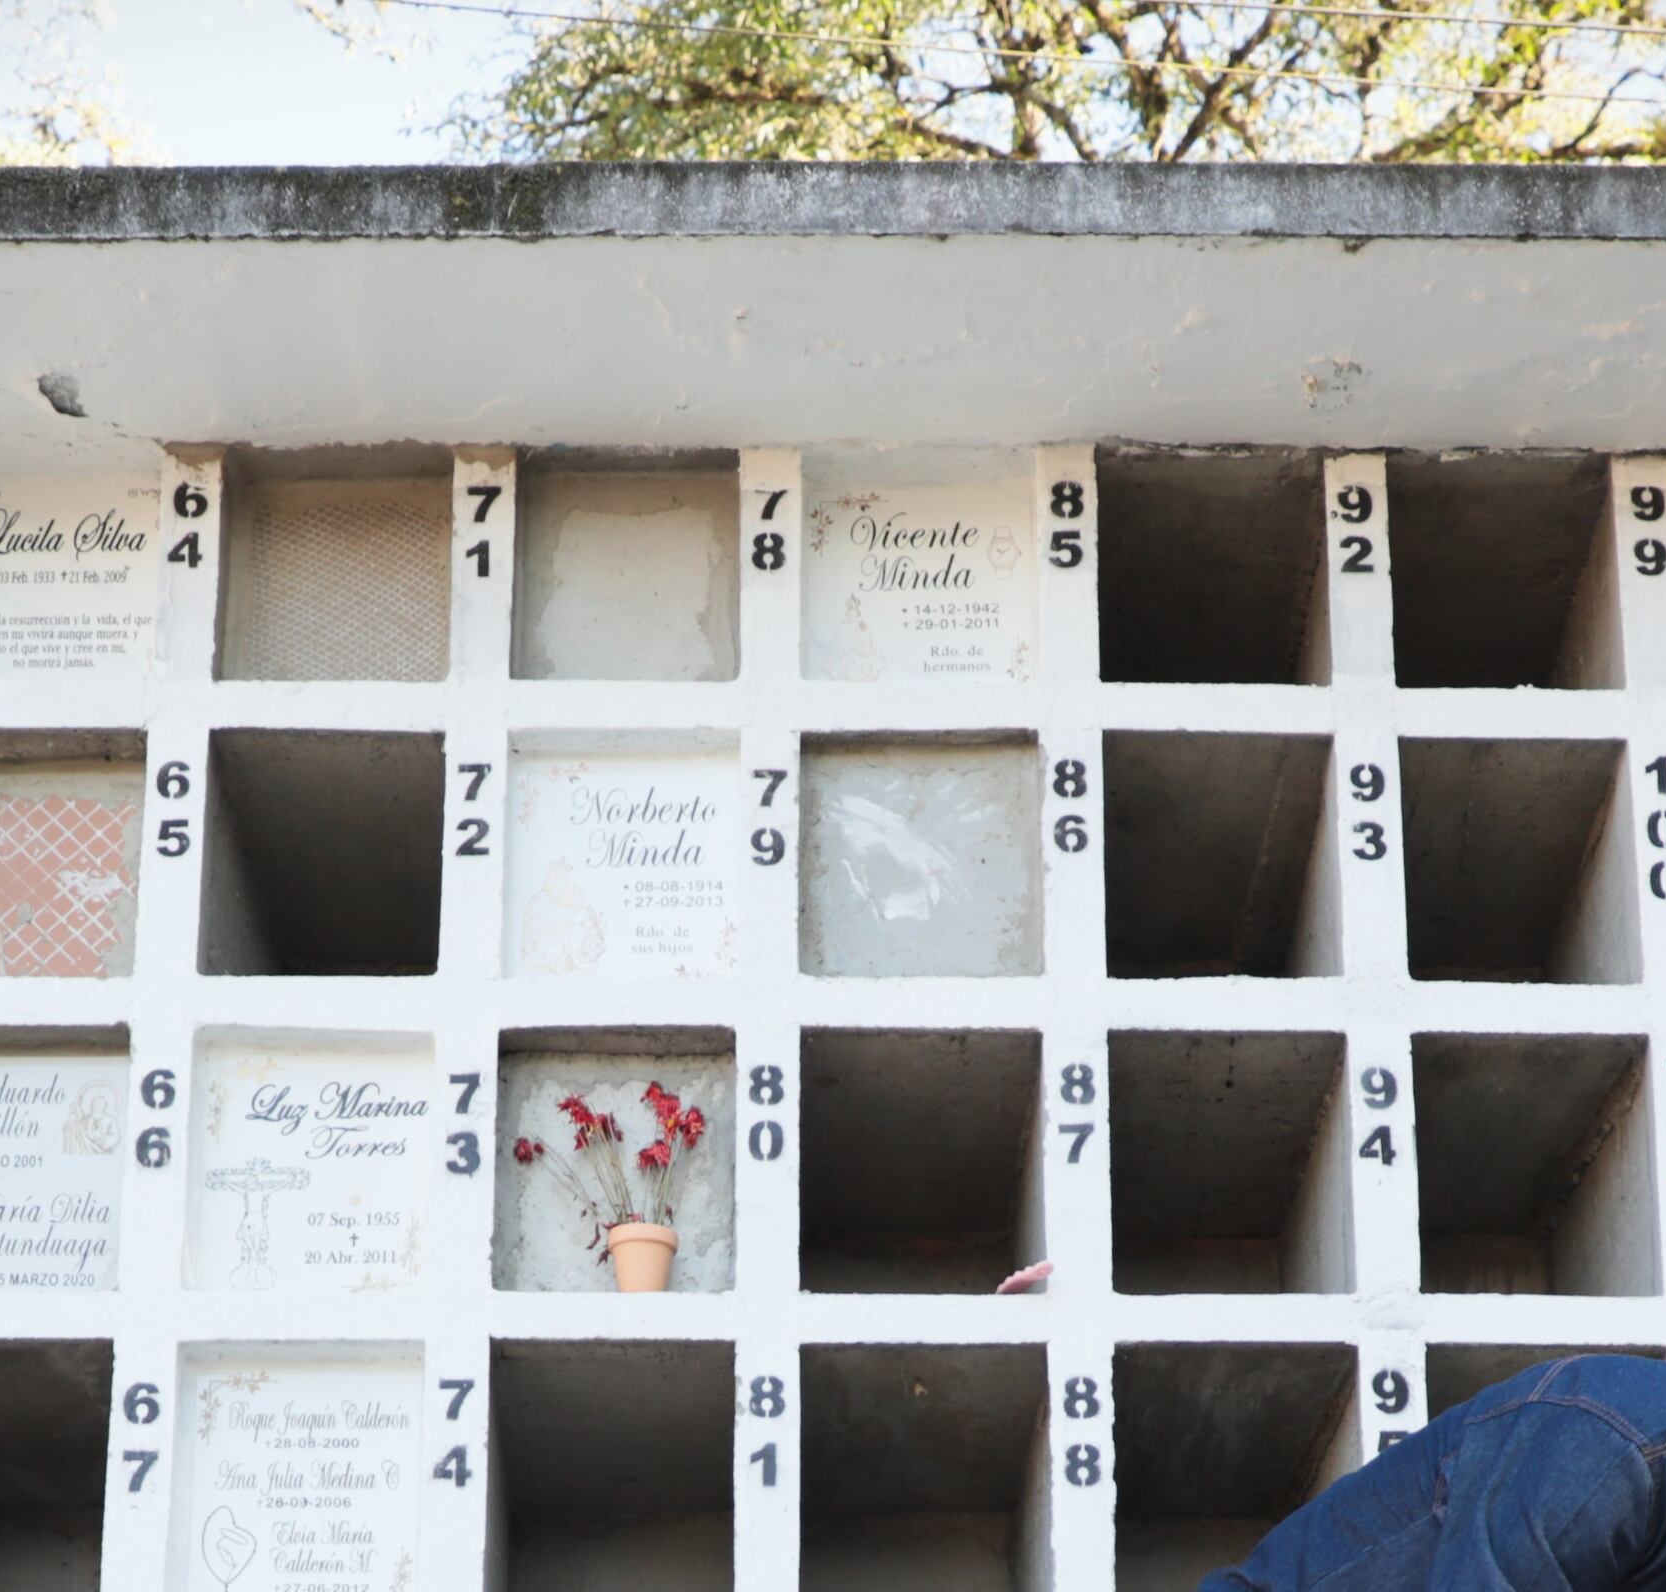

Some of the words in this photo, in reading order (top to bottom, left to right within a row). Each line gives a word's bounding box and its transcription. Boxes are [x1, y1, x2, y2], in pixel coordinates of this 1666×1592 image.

[73, 508, 147, 562] Silva
[851, 513, 979, 552] Vicente
[859, 553, 974, 592] Minda
[571, 787, 719, 823] Norberto
[587, 829, 703, 866] Minda
[246, 1085, 309, 1136] Luz
[315, 1082, 429, 1120] Marina
[306, 1126, 407, 1158] Torres
[14, 1156, 44, 1168] 2001
[368, 1214, 400, 1226] 1955
